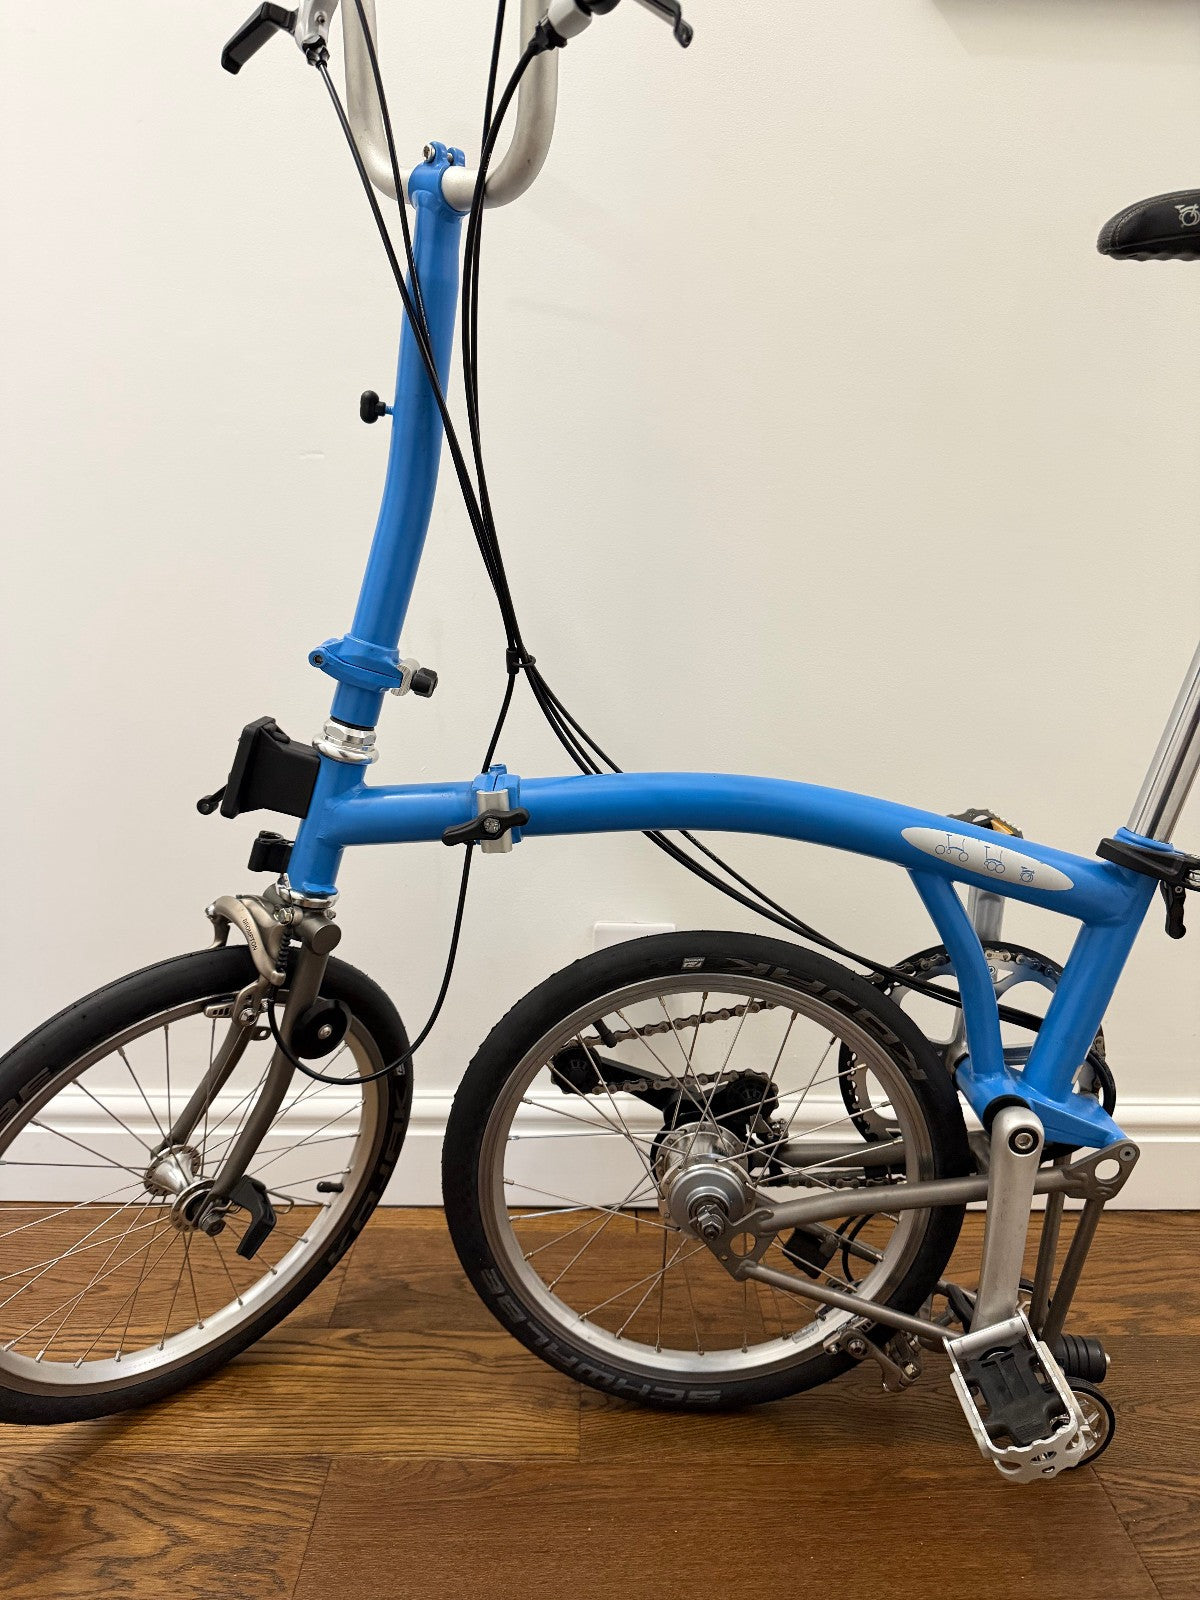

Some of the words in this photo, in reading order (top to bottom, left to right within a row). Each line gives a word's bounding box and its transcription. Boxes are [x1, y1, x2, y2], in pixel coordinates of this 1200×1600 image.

[242, 918, 257, 951] BROMPTON
[722, 957, 927, 1080] KOJAK
[480, 1269, 722, 1403] SCHWALBE
